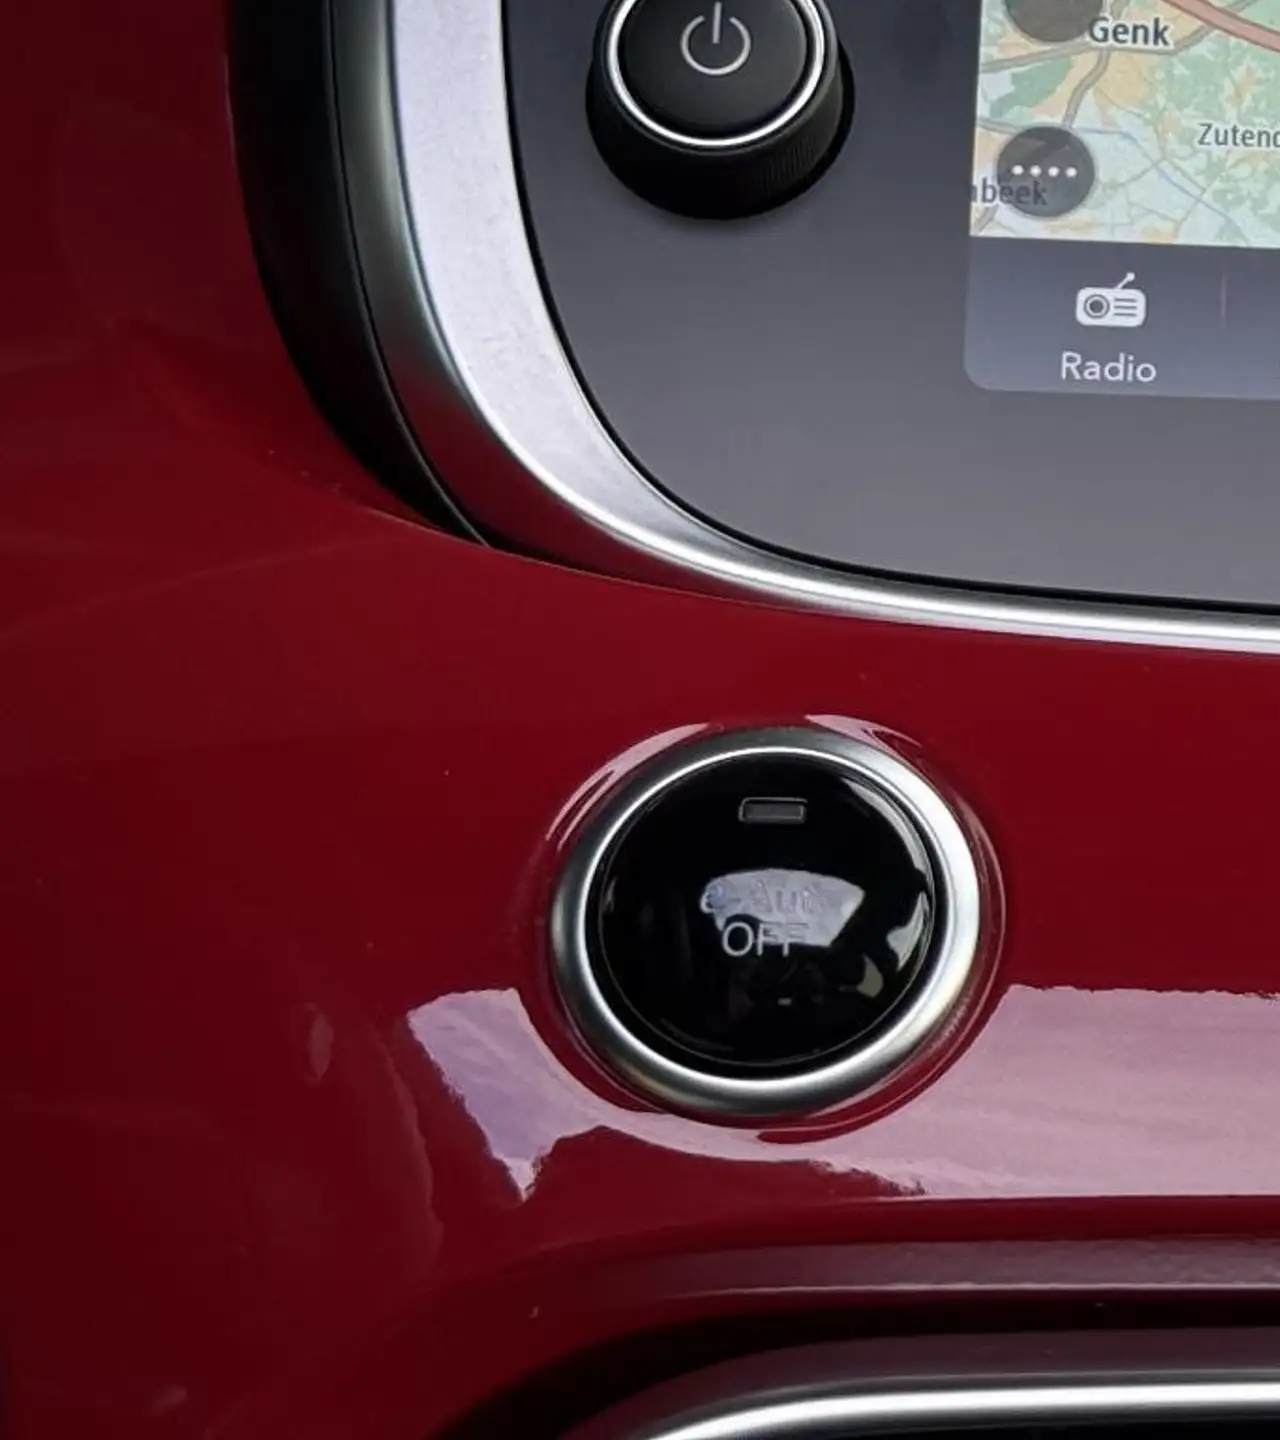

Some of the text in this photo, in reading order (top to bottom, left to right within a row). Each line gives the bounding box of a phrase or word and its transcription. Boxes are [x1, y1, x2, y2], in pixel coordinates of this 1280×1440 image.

[1088, 16, 1171, 47] Genk
[971, 177, 1049, 206] beek
[1061, 351, 1157, 384] Radio
[721, 920, 809, 958] OFF
